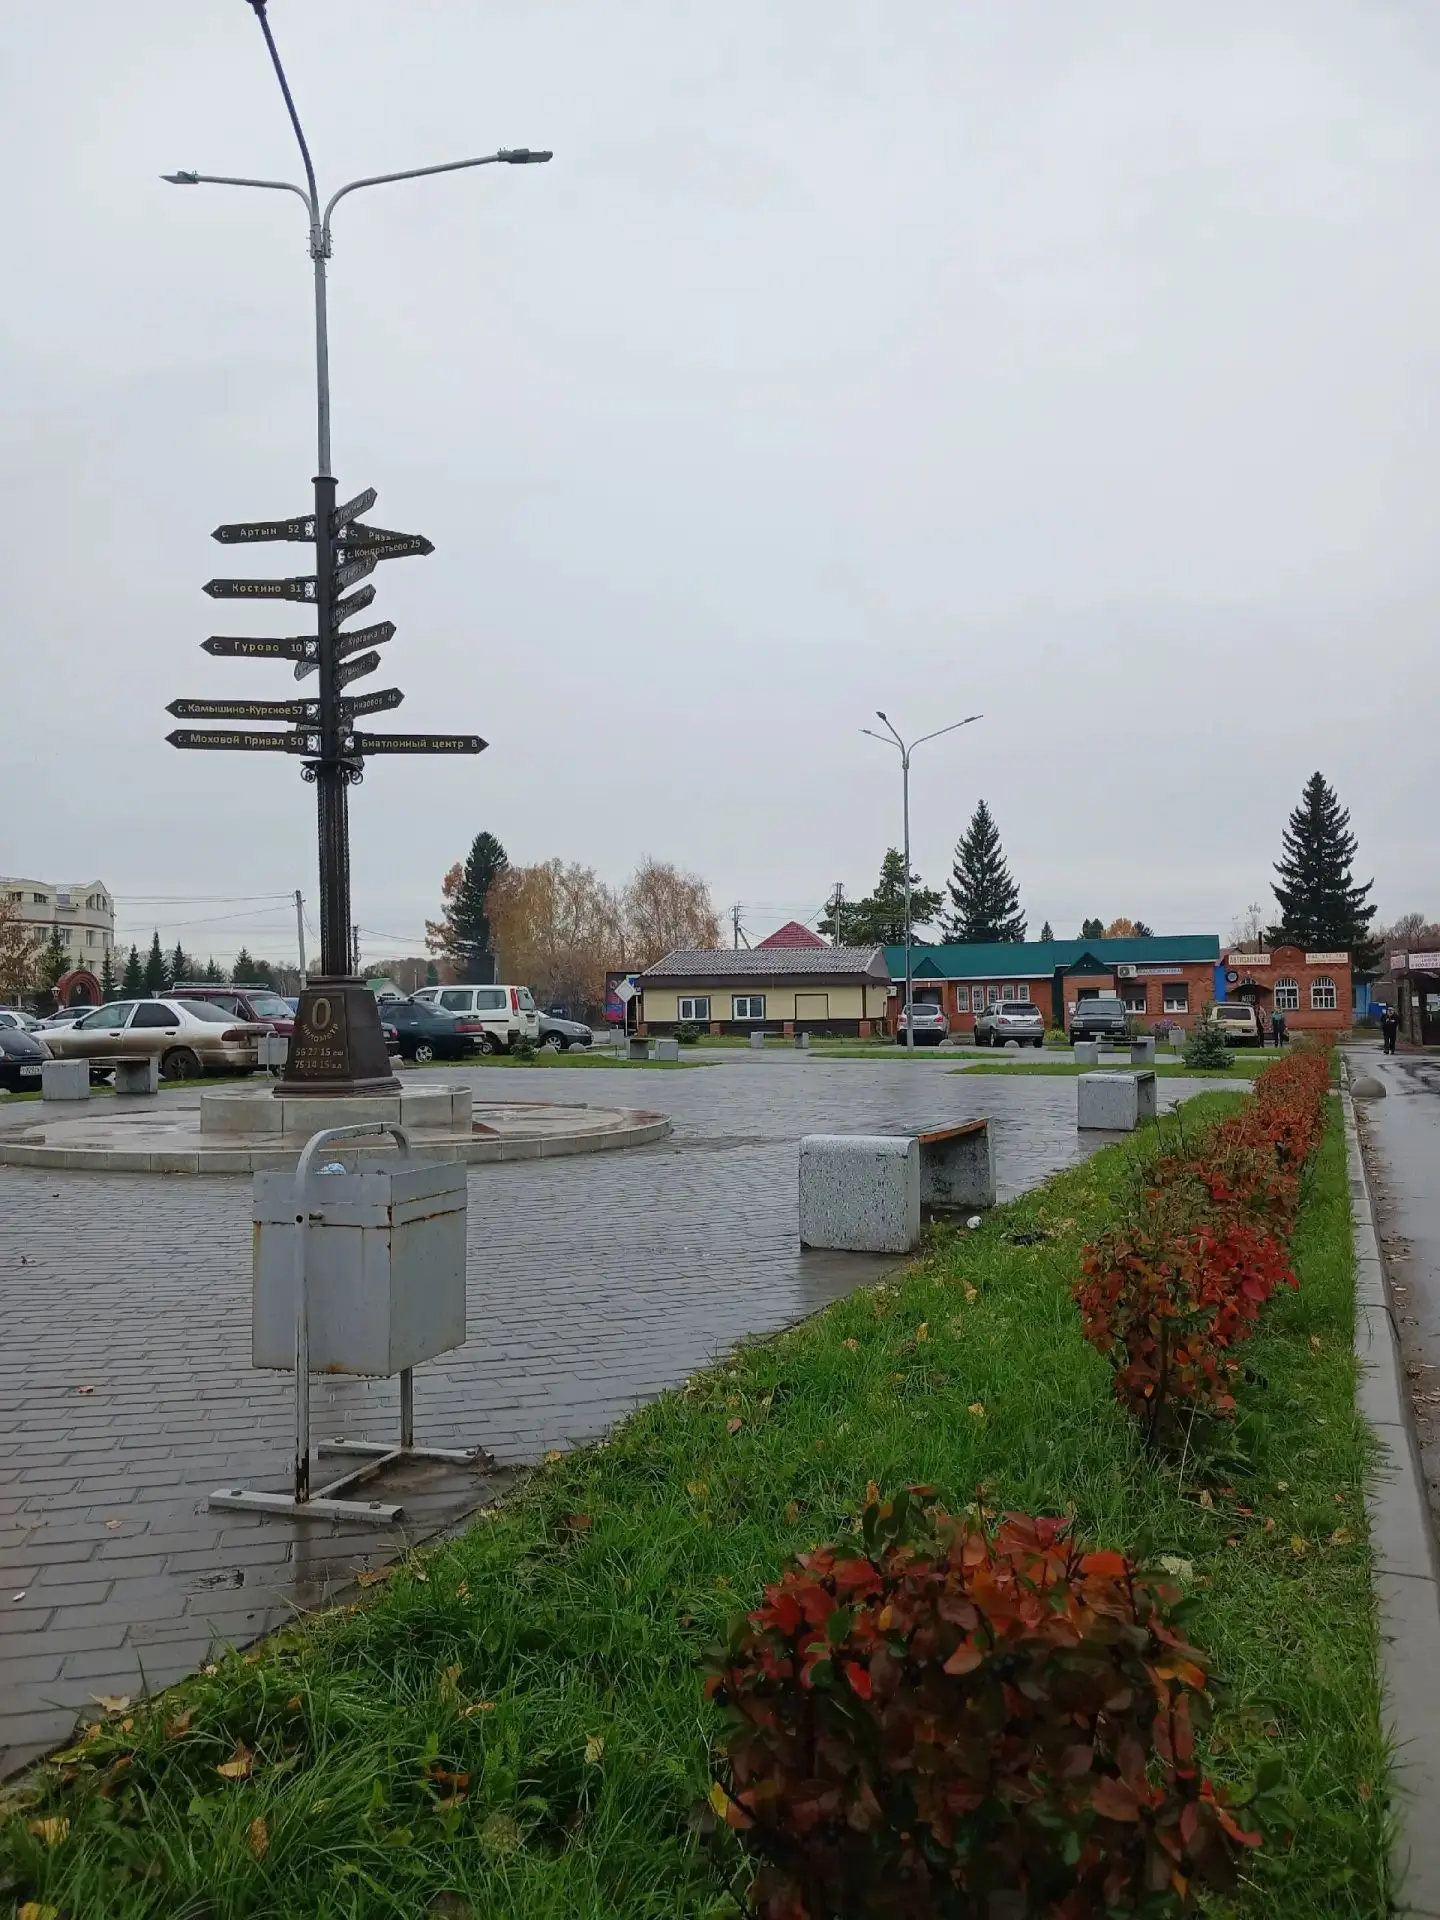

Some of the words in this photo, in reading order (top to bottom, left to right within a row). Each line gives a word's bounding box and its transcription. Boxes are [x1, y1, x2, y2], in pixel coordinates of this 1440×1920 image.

[221, 530, 229, 538] с.
[240, 527, 277, 538] Артын
[288, 524, 300, 533] 52
[354, 543, 408, 557] Кондратьево
[410, 540, 421, 549] 25
[232, 583, 281, 593] Костино
[289, 584, 301, 593] 31
[213, 642, 222, 650] с.
[234, 641, 280, 653] Гурово
[290, 643, 303, 653] 10
[177, 705, 186, 713] с.
[187, 703, 291, 716] Камышино-Курское
[292, 705, 303, 715] 57
[177, 735, 186, 743] с.
[190, 733, 240, 744] Моховой
[244, 735, 284, 746] Привал
[290, 737, 304, 746] 50
[361, 738, 427, 748] Биатлонный
[432, 741, 464, 750] центр
[311, 997, 332, 1030] 0
